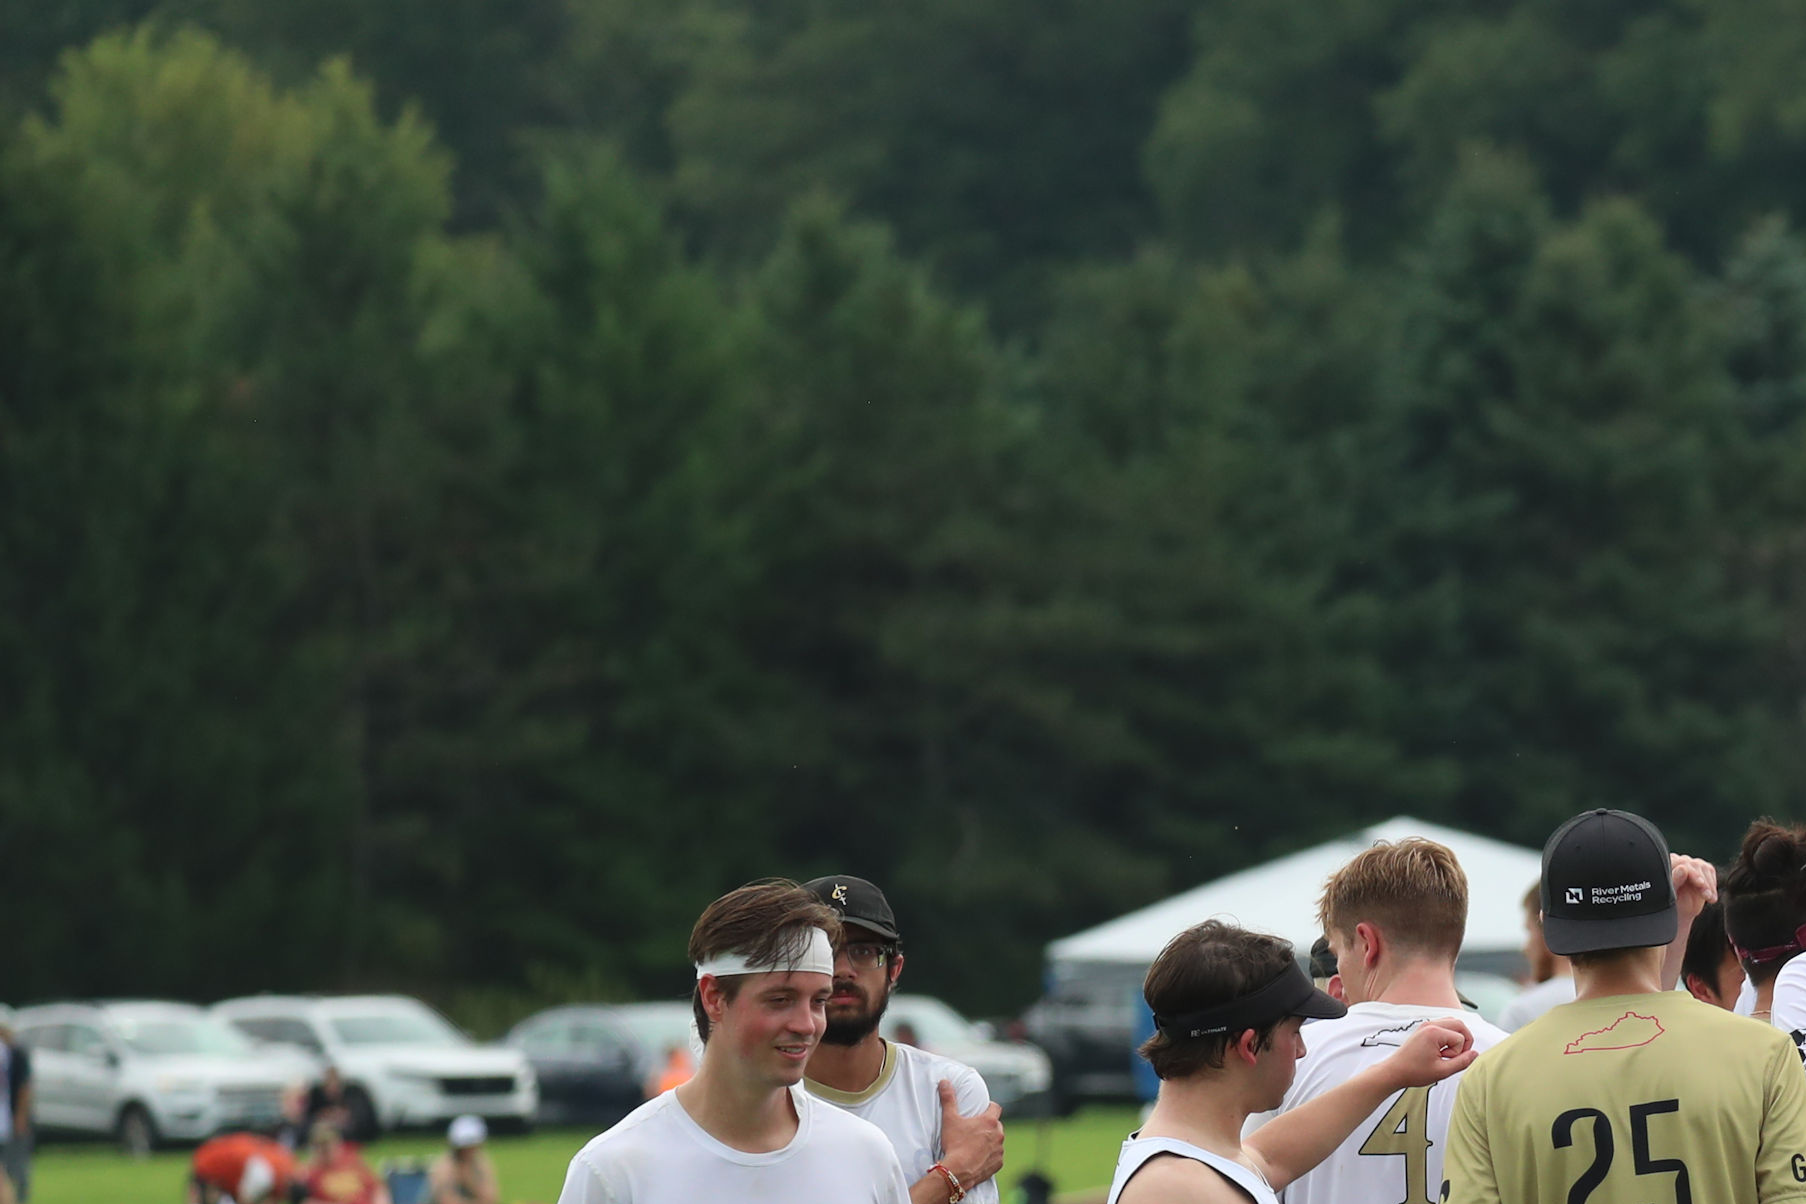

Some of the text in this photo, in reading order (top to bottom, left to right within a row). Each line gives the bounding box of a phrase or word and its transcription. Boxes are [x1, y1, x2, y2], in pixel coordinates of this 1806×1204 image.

[1591, 881, 1652, 896] River Metals
[1591, 892, 1642, 905] Recycling
